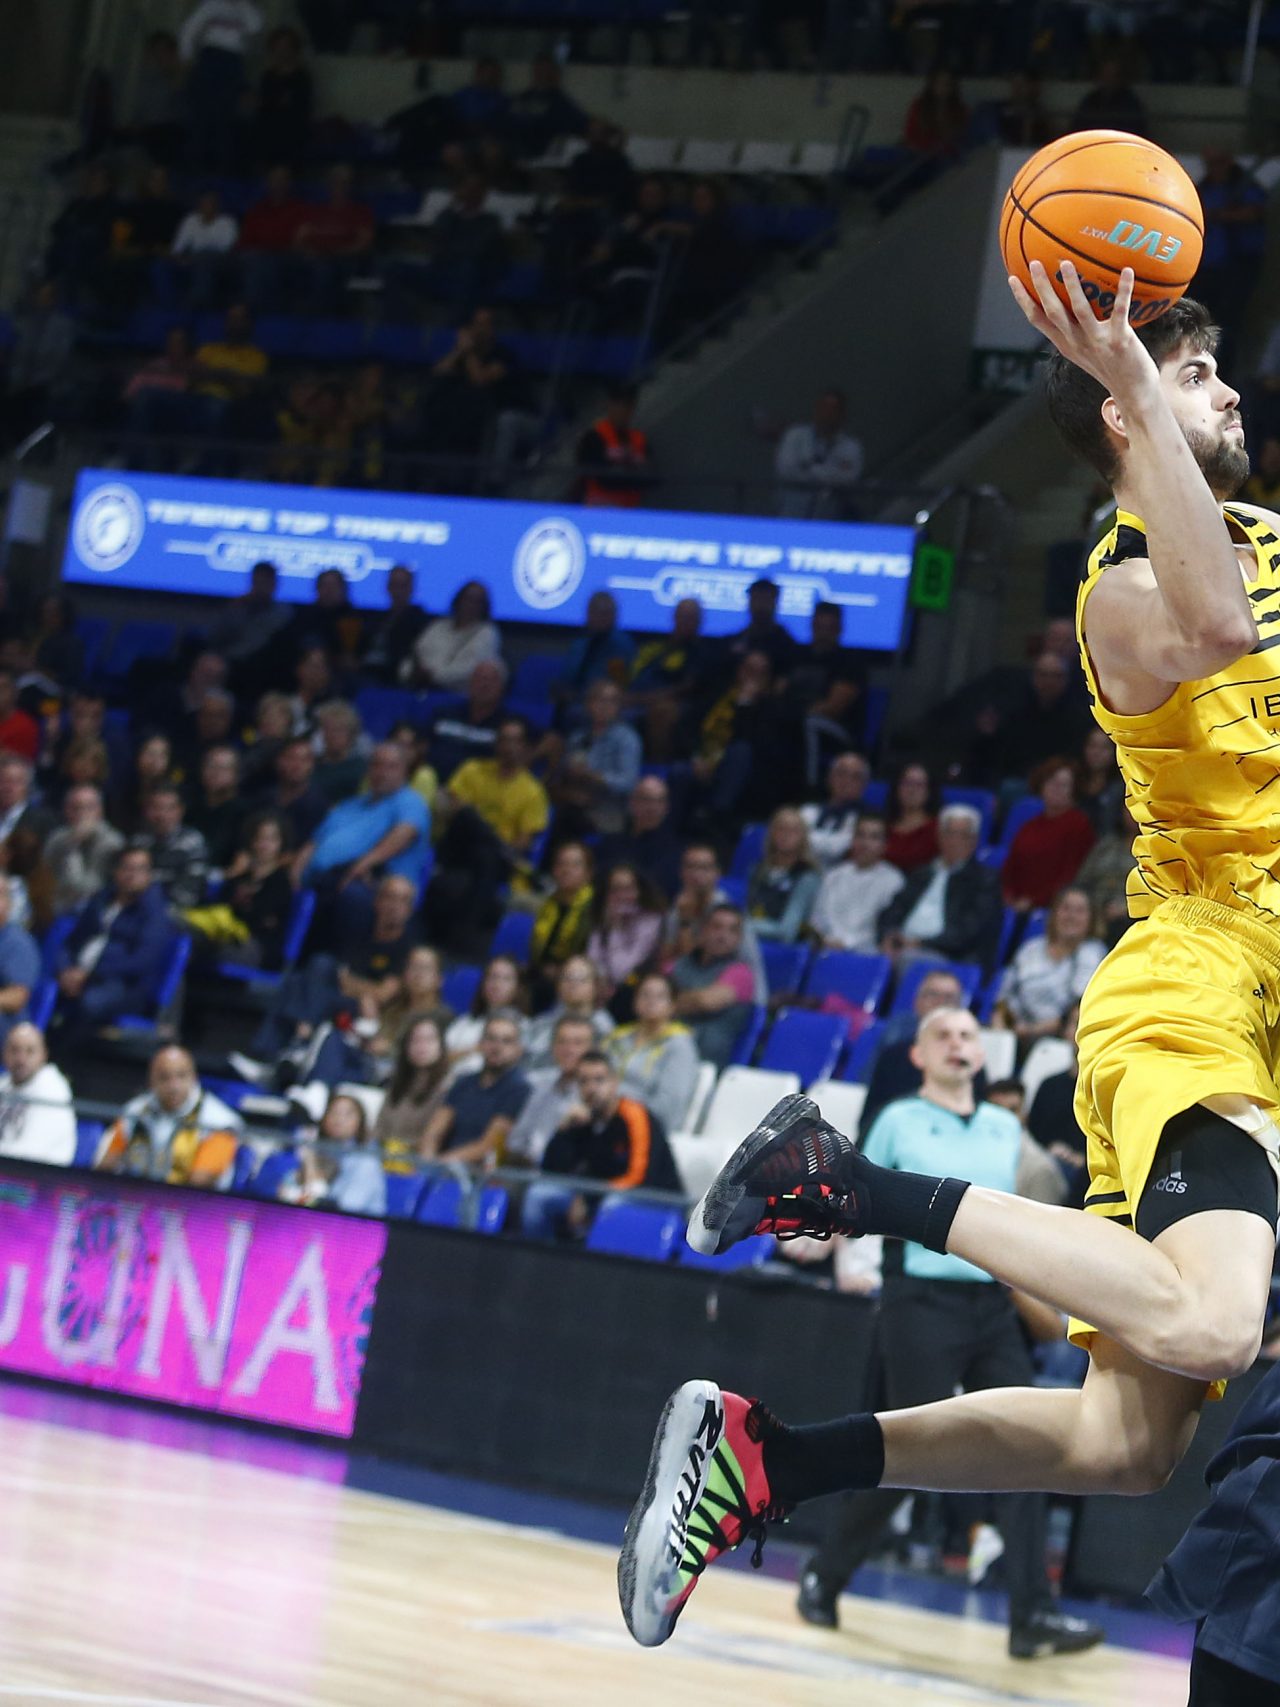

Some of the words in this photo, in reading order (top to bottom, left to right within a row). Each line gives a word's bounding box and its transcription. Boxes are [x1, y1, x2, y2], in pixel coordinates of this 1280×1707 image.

[1108, 220, 1182, 264] EVO
[275, 508, 330, 536] TOP
[588, 533, 720, 565] TENERIFE
[726, 543, 782, 569] TOP
[787, 547, 912, 577] TRAINING
